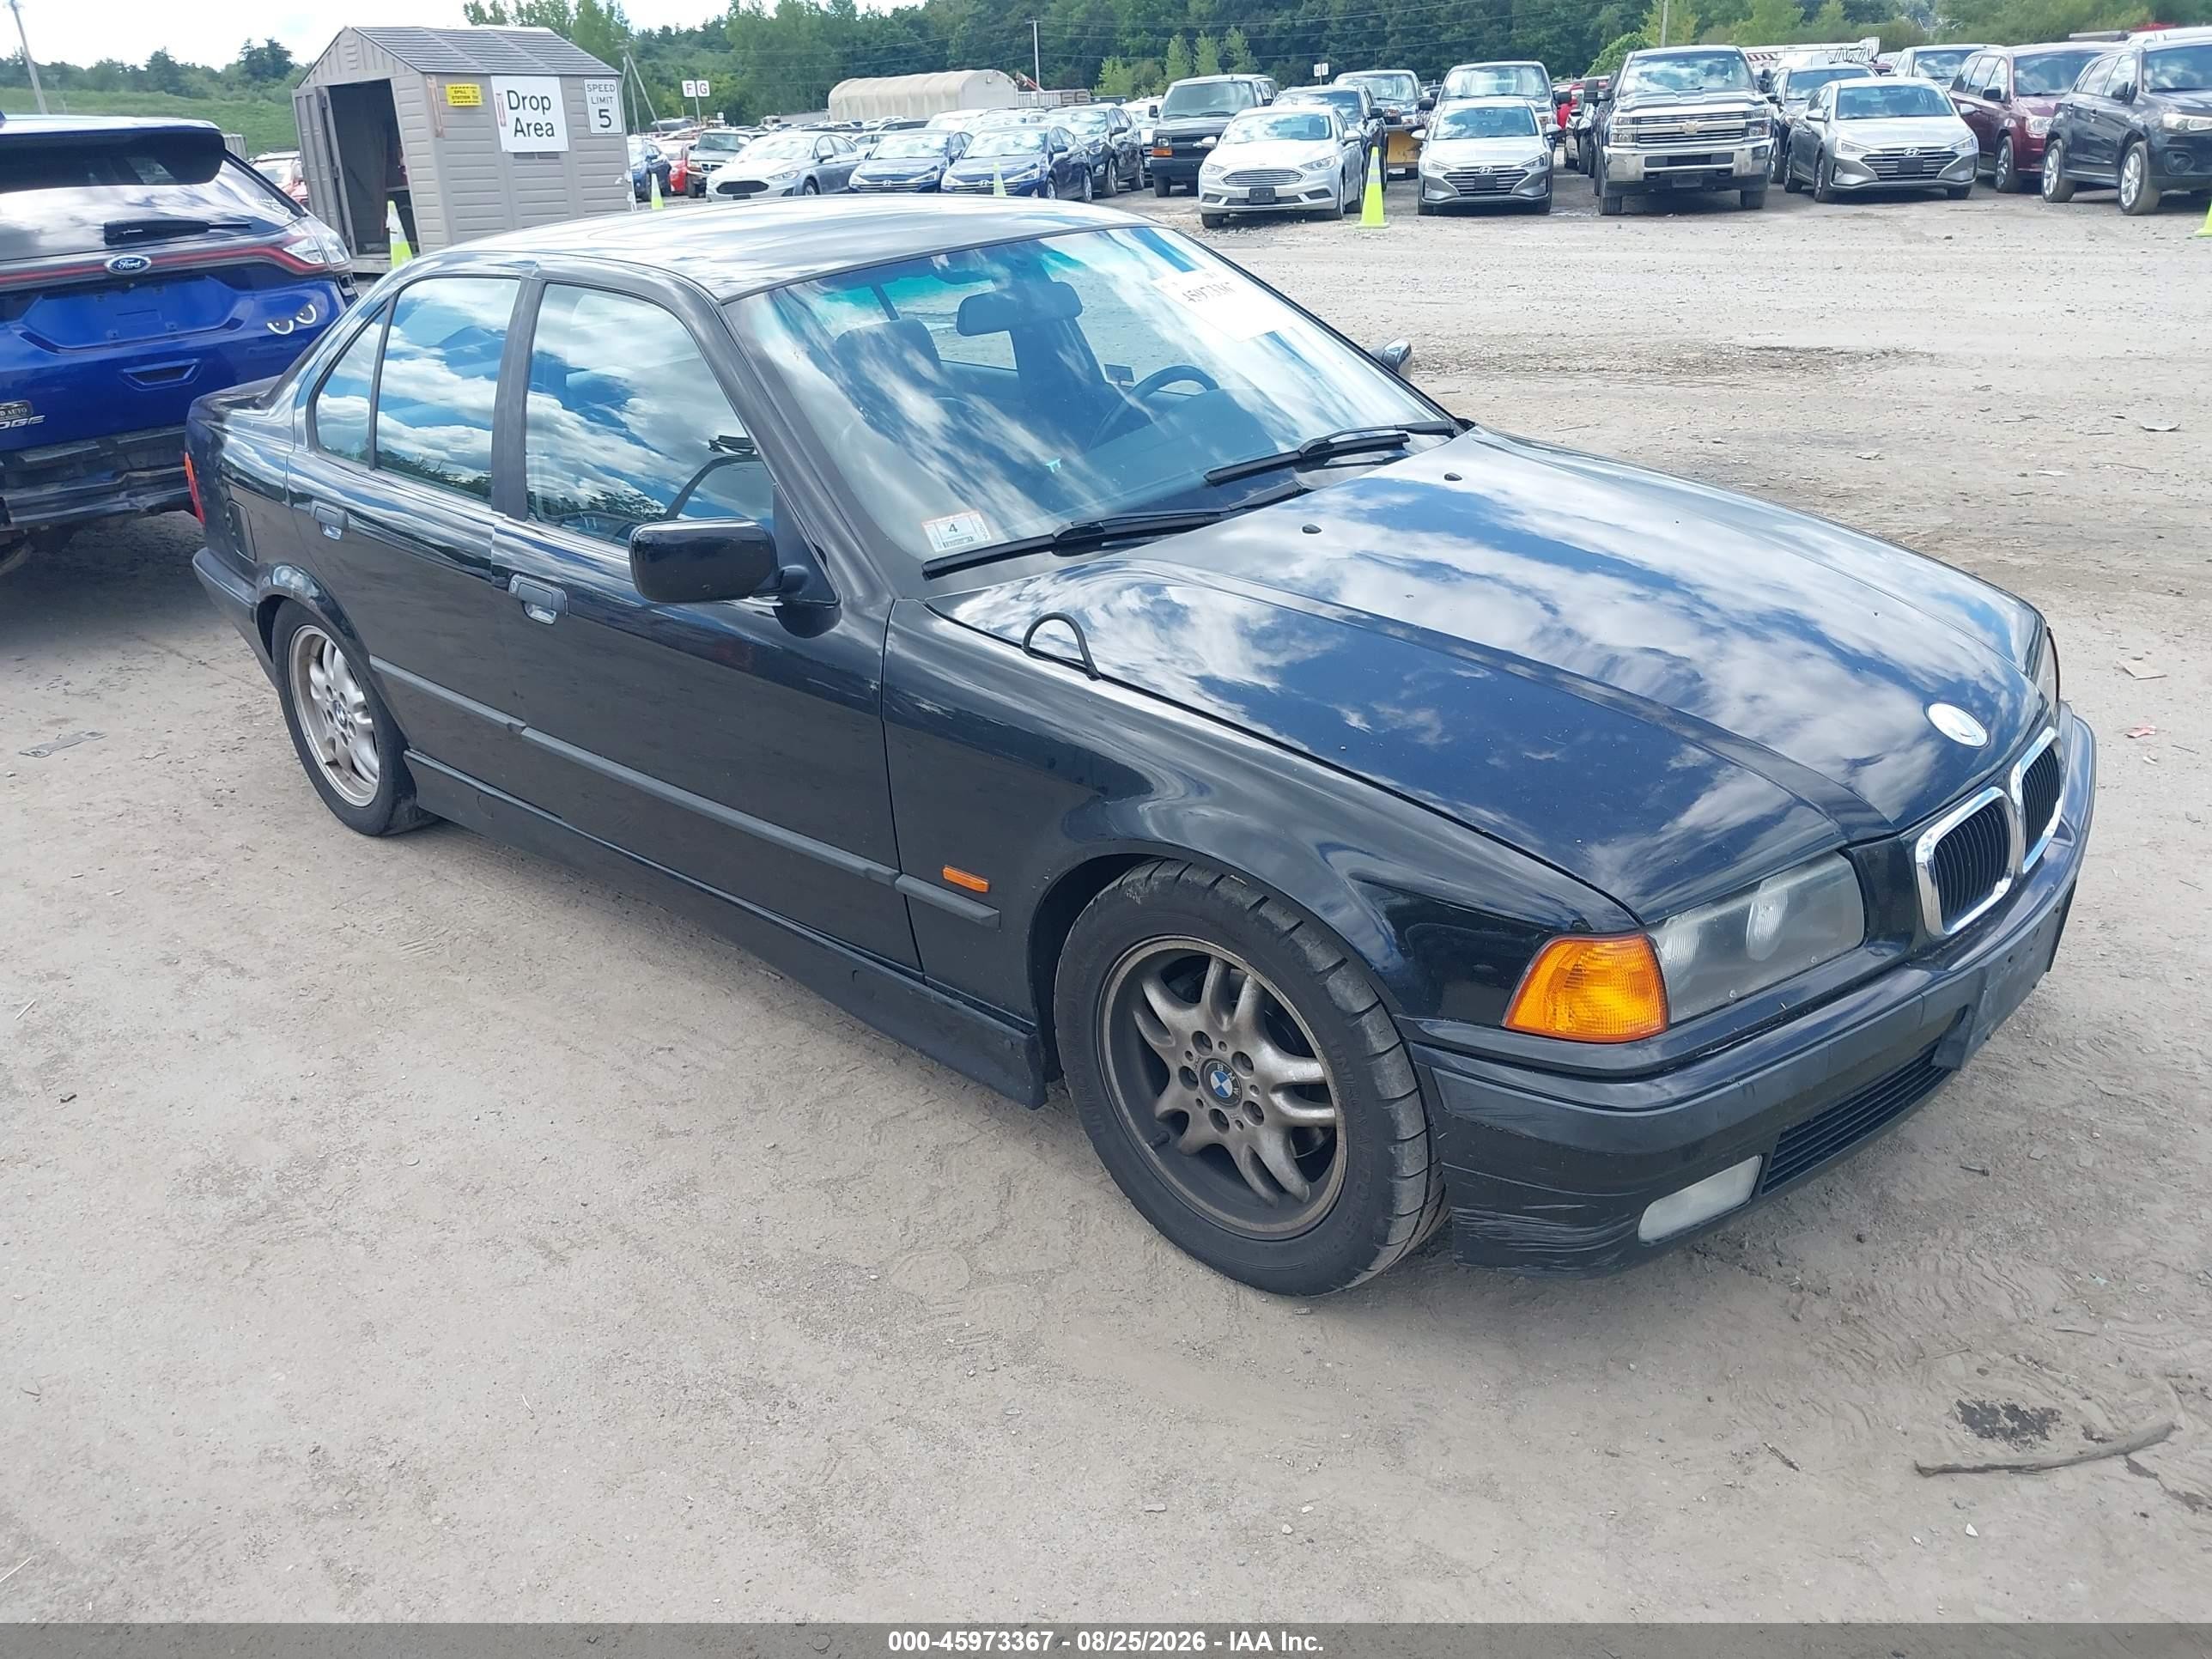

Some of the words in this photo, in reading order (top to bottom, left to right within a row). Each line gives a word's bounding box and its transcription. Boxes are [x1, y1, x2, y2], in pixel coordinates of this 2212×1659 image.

[586, 83, 616, 93] SPEED
[686, 83, 692, 94] F
[699, 82, 708, 94] G
[507, 89, 552, 116] Drop
[590, 96, 614, 105] LIMIT
[599, 108, 612, 129] 5
[514, 117, 556, 138] Area
[118, 258, 141, 270] Ford
[948, 523, 958, 533] 4
[1216, 1063, 1240, 1096] BMW
